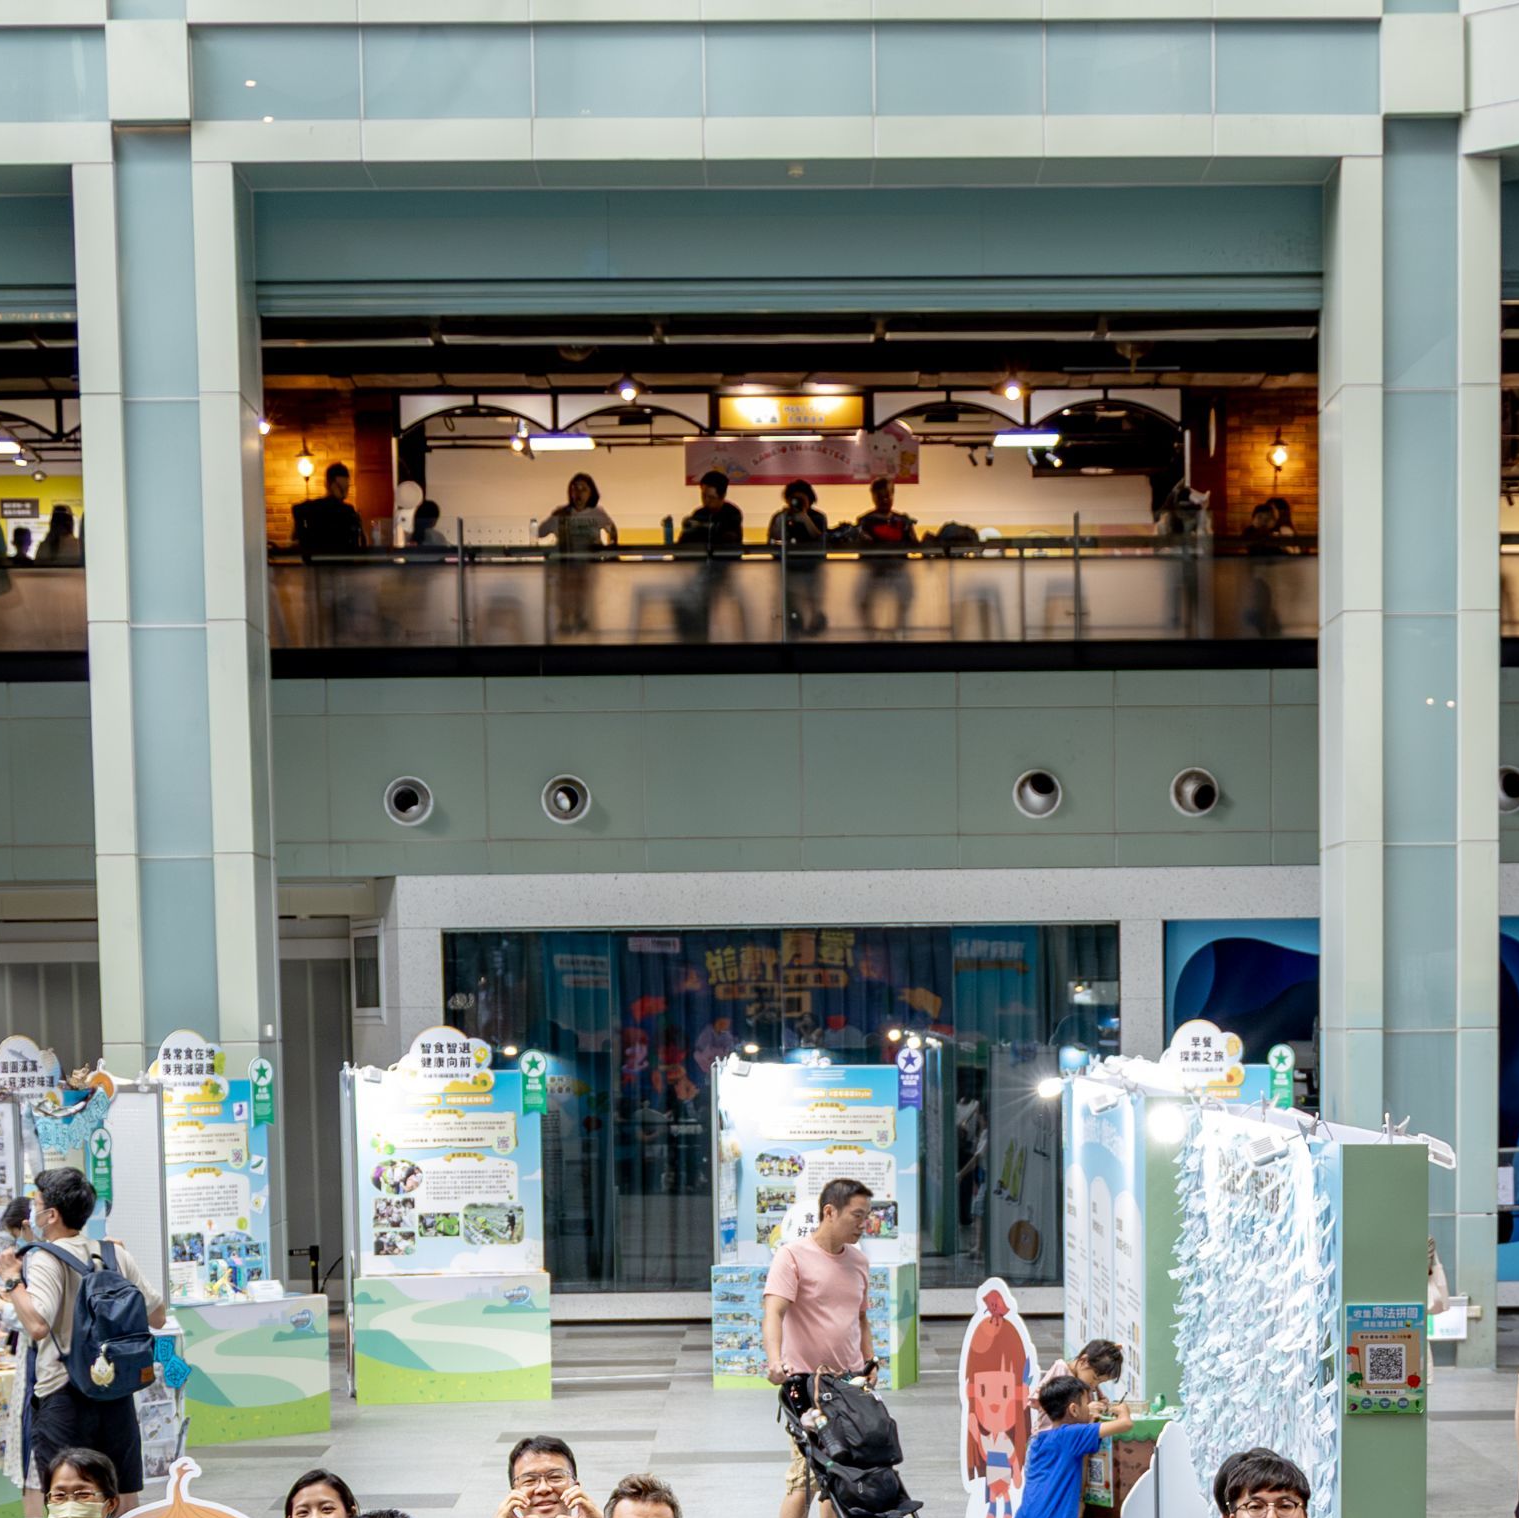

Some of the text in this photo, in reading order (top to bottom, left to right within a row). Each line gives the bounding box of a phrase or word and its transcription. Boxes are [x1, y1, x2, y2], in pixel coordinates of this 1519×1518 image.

[420, 1041, 471, 1055] 智食智選
[1190, 1036, 1213, 1048] 早餐
[420, 1055, 471, 1069] 健康向前
[1180, 1050, 1225, 1063] 探索之旅
